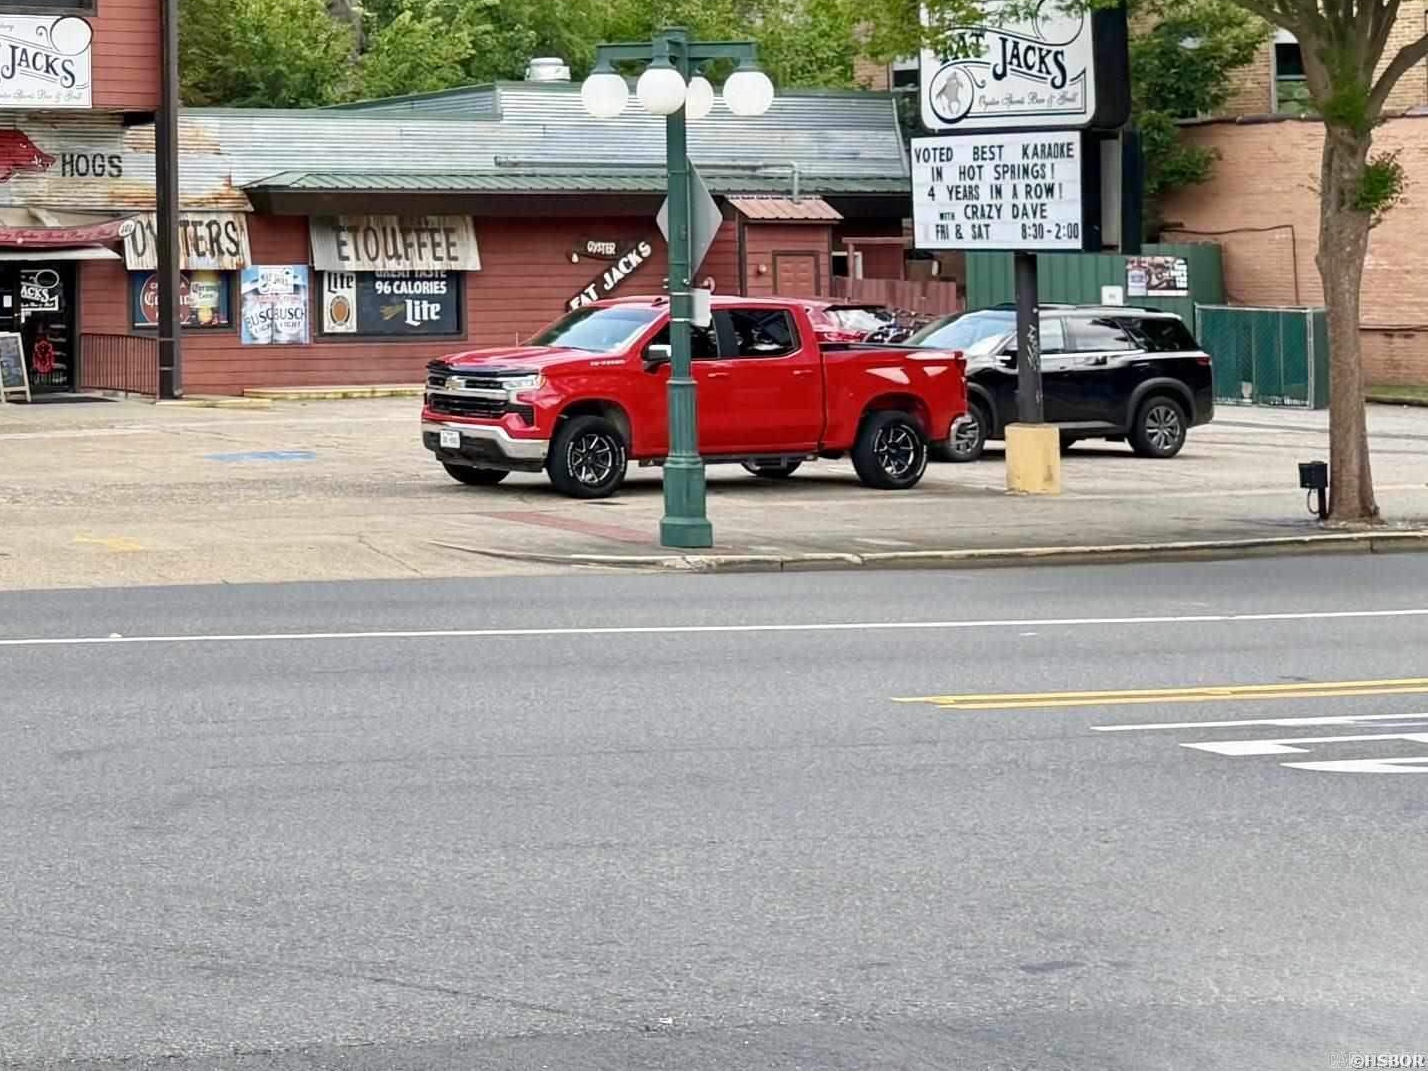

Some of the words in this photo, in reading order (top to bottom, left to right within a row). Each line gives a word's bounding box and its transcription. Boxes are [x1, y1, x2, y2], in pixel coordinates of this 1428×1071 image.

[1, 44, 76, 89] JACKS
[993, 37, 1067, 89] JACKS
[914, 147, 954, 163] VOTED
[973, 145, 1004, 161] BEST
[1022, 142, 1075, 159] KARAOKE
[61, 152, 123, 178] HOGS
[931, 166, 943, 182] IN
[959, 165, 984, 181] HOT
[927, 186, 935, 201] 4
[947, 184, 980, 201] YEARS
[990, 184, 1002, 200] IN
[1012, 184, 1018, 200] A
[940, 212, 955, 221] WITH
[964, 203, 1002, 220] CRAZY
[1012, 203, 1047, 219] DAVE
[132, 219, 240, 258] OTERS
[936, 224, 949, 240] FRI
[955, 224, 963, 240] &
[972, 224, 990, 240] SAT
[337, 225, 459, 264] ETOUFFEE
[587, 241, 616, 255] OYSTER
[327, 271, 354, 294] Lite
[376, 270, 410, 279] GREAT
[414, 270, 447, 279] TASTE
[570, 284, 599, 310] FAT
[604, 241, 652, 290] JACKS
[20, 285, 50, 303] ACKS
[375, 281, 391, 294] 96
[393, 281, 447, 294] CALORIES
[244, 308, 273, 328] BUSC
[405, 299, 441, 326] Lite
